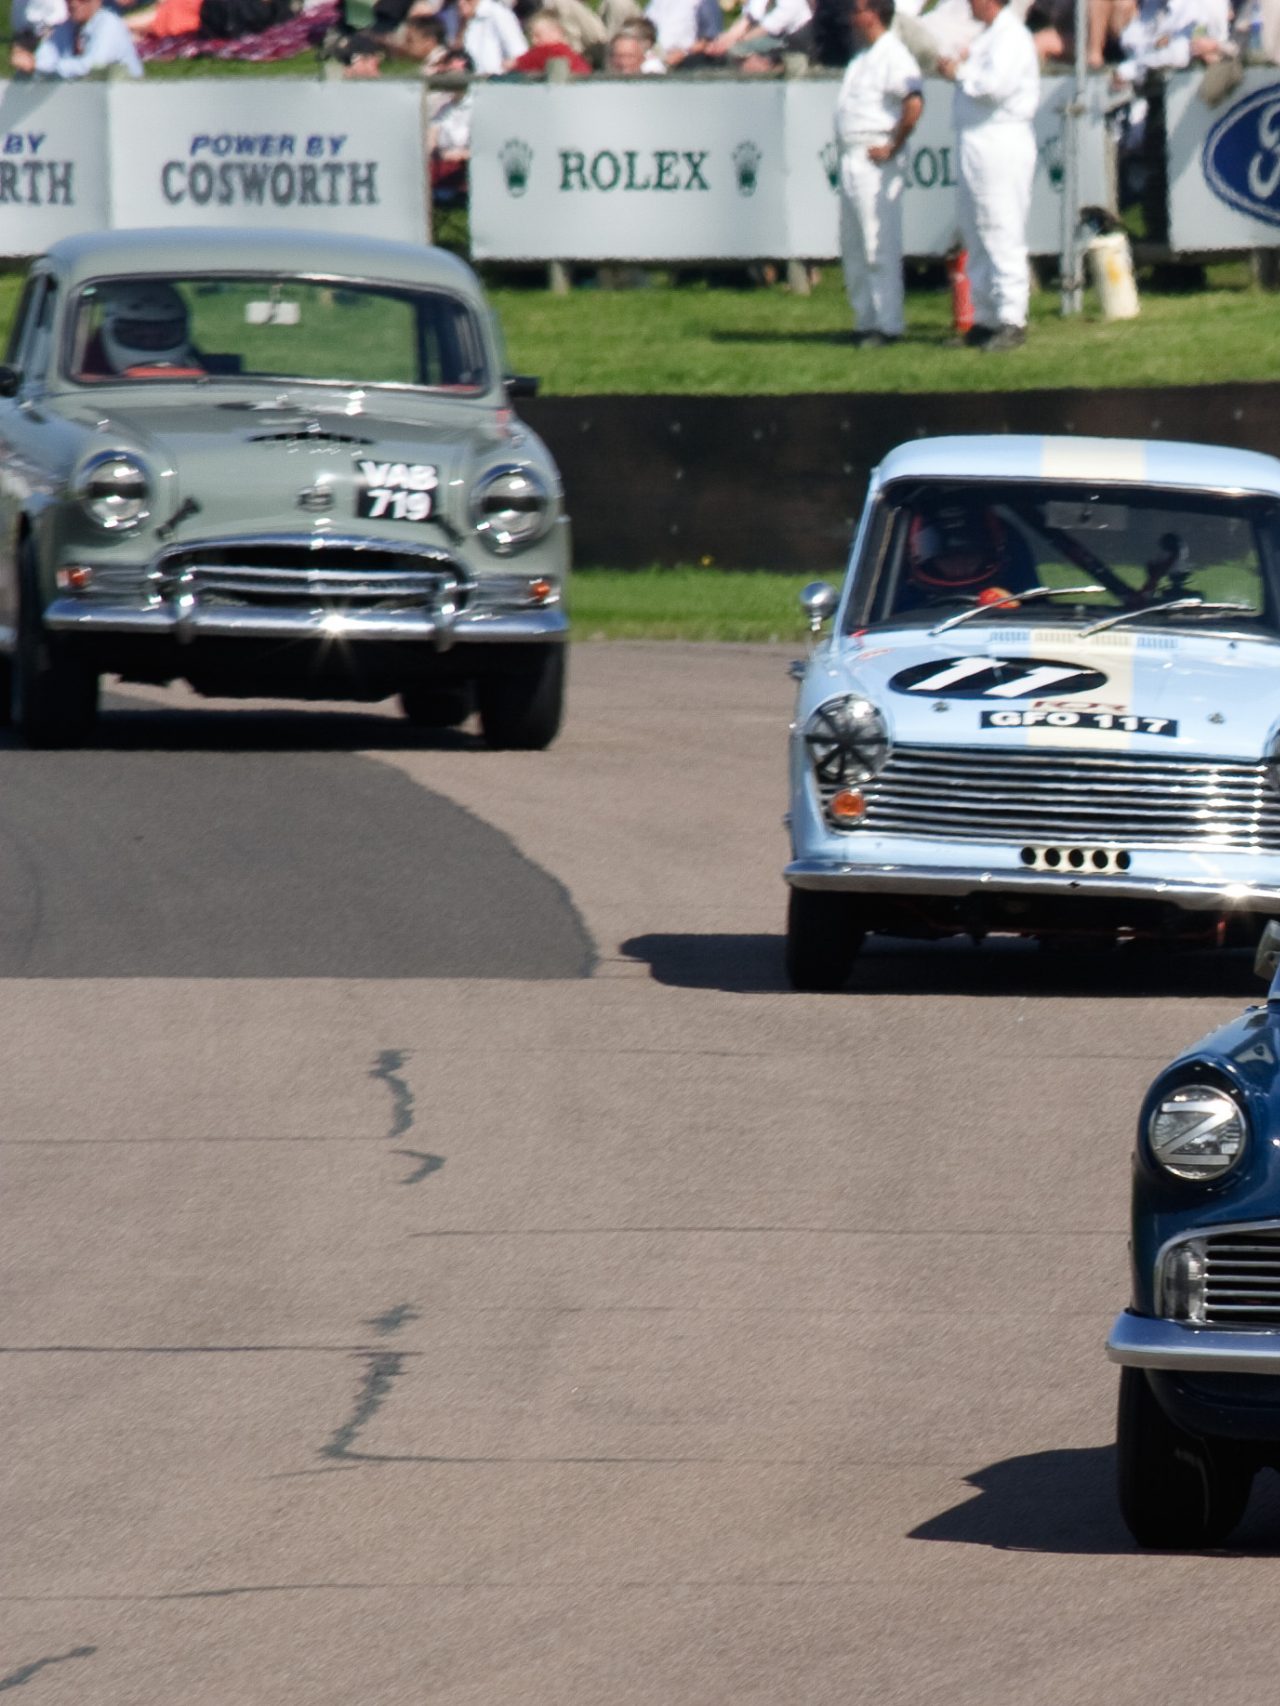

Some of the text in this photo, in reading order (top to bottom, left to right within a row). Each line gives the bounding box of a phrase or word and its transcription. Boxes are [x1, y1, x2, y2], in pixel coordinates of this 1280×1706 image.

[4, 133, 46, 154] BY
[190, 134, 347, 156] POWER BY
[161, 161, 379, 205] COSWORTH
[558, 150, 710, 191] ROLEX
[367, 489, 432, 520] 719
[990, 711, 1169, 733] GFO 117
